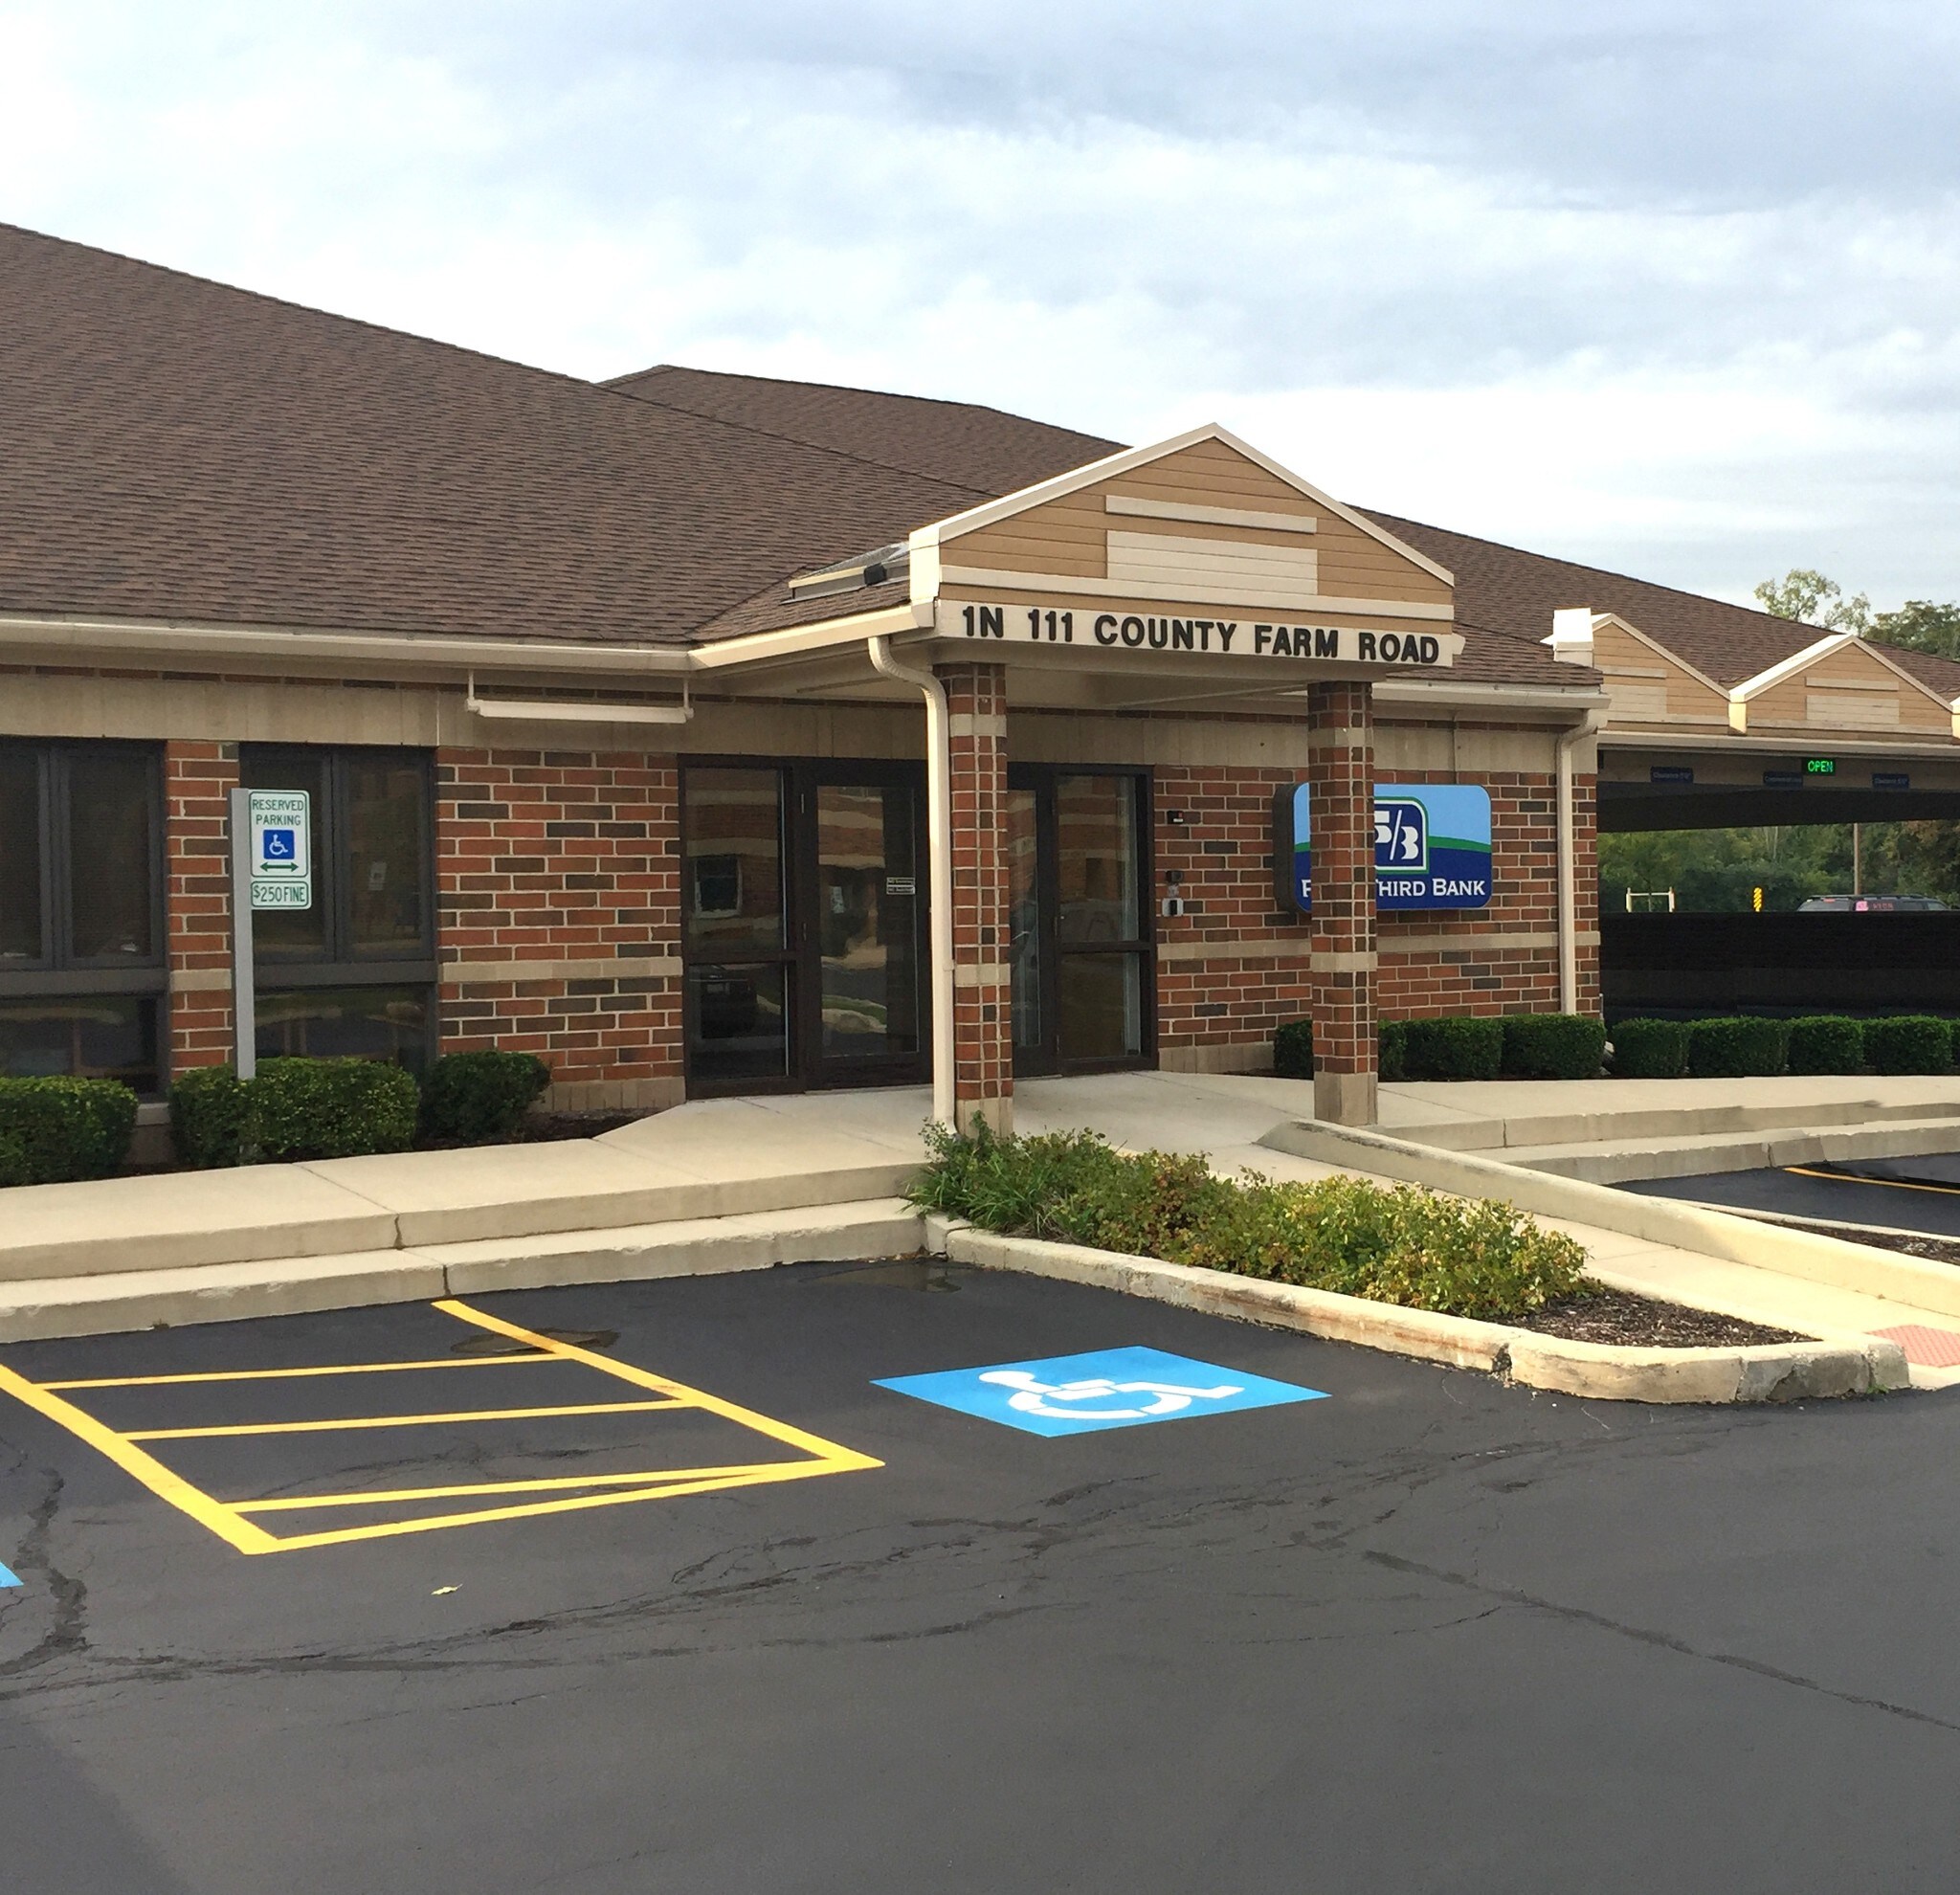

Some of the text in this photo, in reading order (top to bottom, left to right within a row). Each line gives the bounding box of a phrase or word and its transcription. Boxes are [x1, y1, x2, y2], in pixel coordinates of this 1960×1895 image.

[962, 605, 1439, 664] 1N 111 COUNTY FARM ROAD
[1807, 760, 1834, 772] OPEN
[252, 799, 304, 812] RESERVED
[256, 814, 301, 826] PARKING
[253, 884, 305, 903] $250 FINE
[1375, 878, 1485, 897] HIRD BANK
